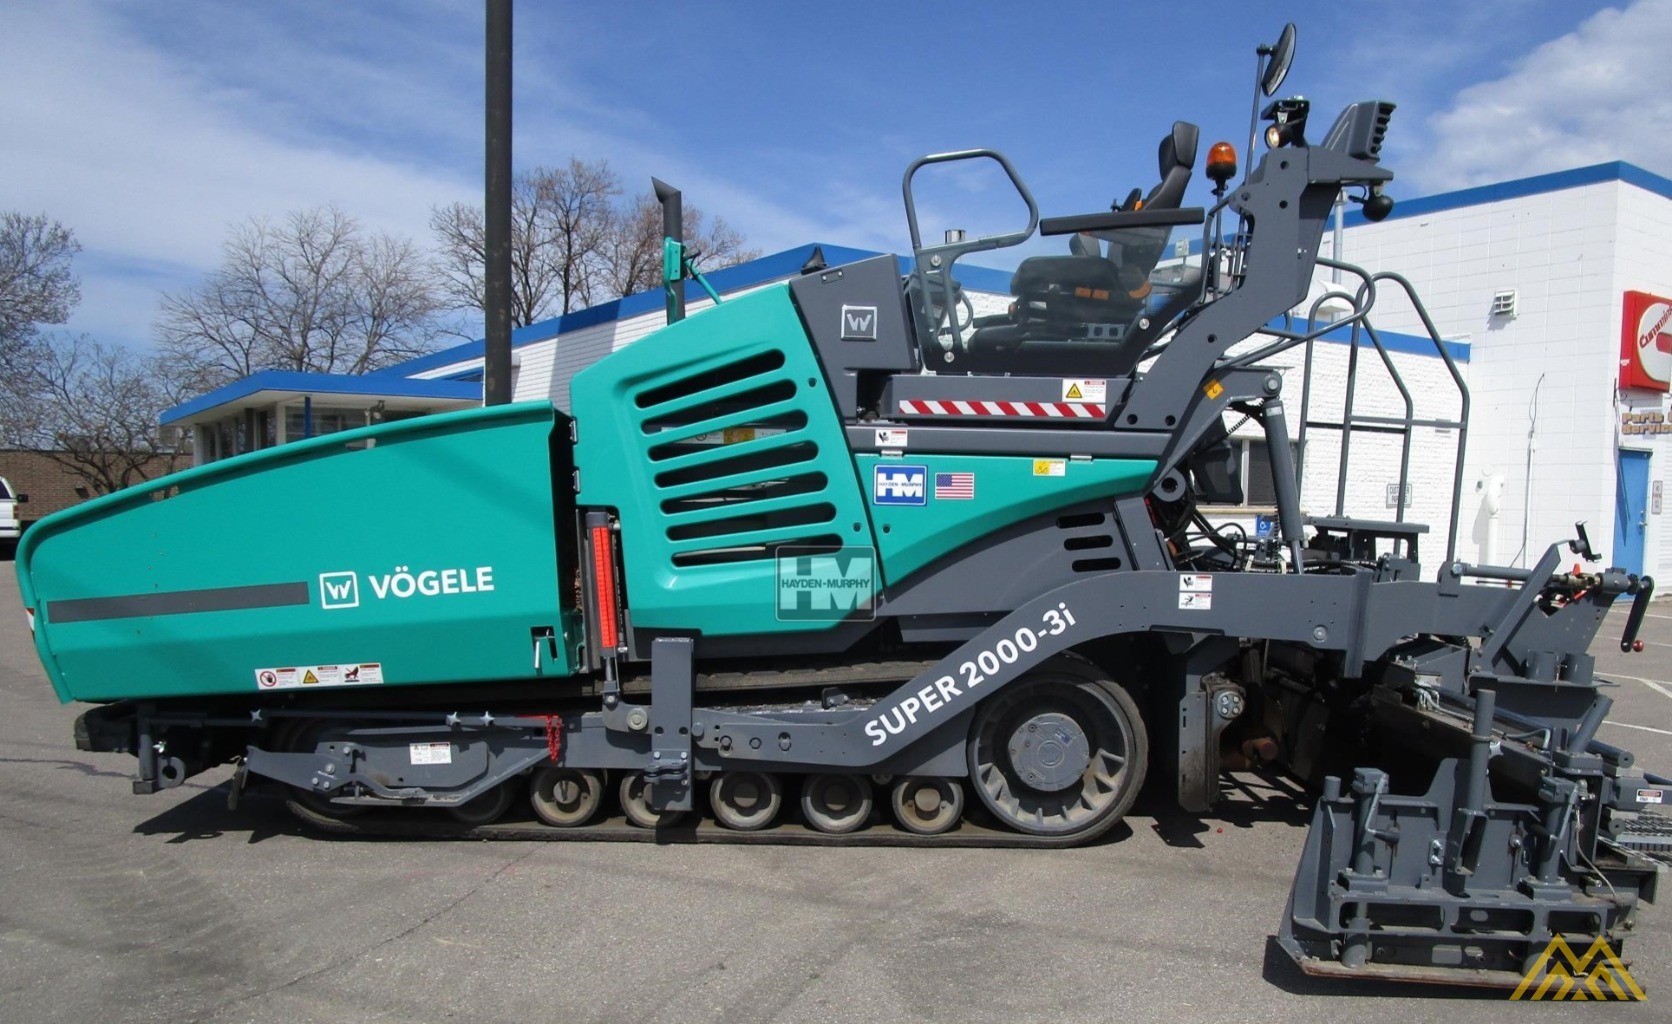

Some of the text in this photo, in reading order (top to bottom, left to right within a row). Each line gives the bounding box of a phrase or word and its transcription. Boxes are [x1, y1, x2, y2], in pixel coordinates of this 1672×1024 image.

[1622, 412, 1664, 424] Parts
[1622, 424, 1672, 435] Servic
[368, 565, 495, 599] VÖGELE
[864, 602, 1076, 747] SUPER 2000-3i
